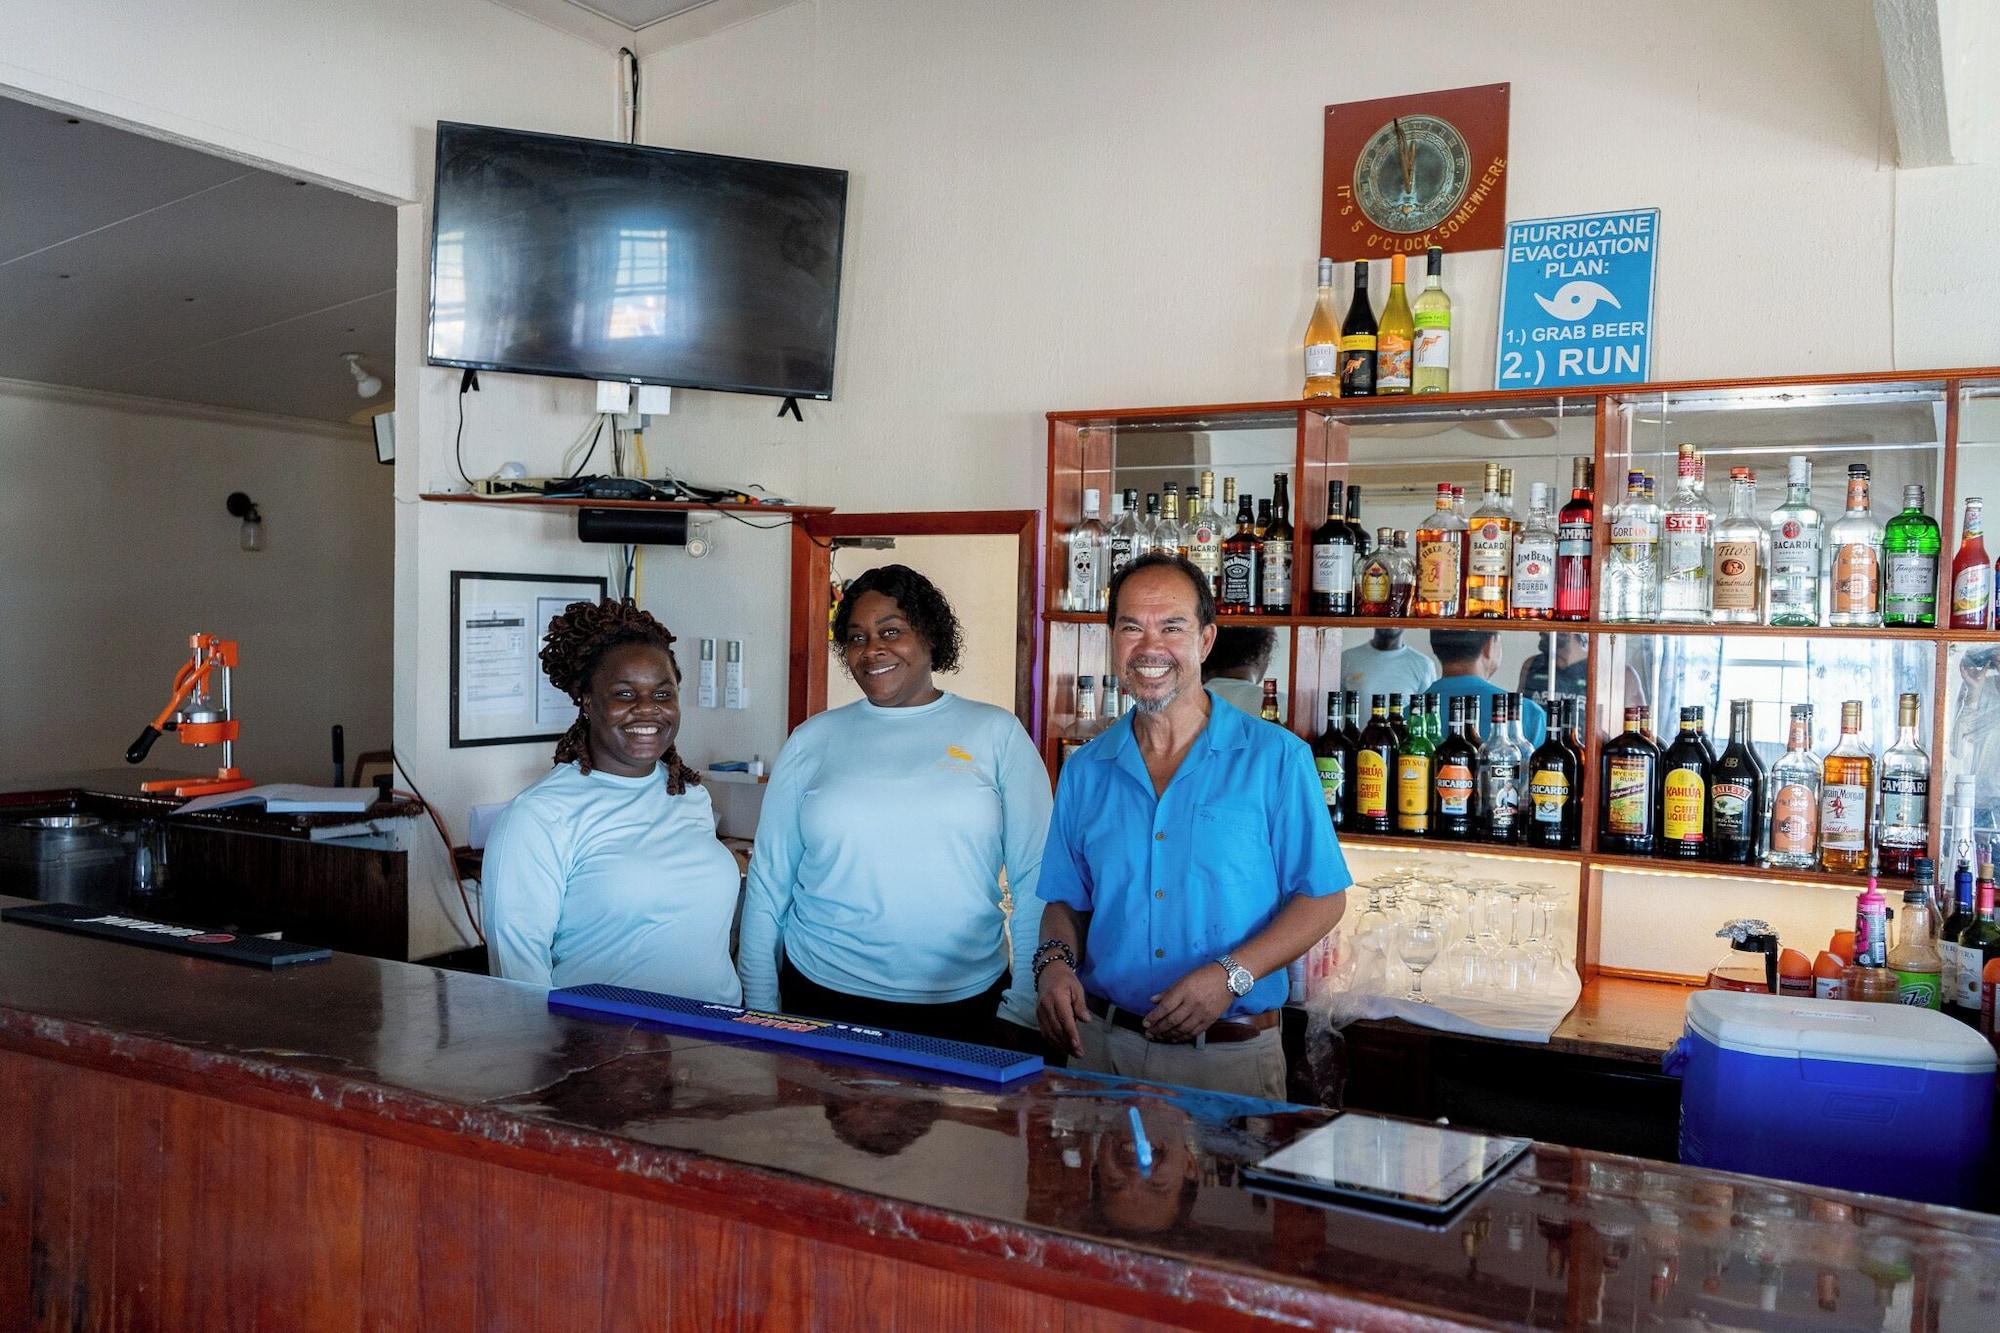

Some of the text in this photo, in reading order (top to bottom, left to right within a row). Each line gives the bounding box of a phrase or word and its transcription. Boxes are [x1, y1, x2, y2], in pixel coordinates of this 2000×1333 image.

[1337, 185, 1353, 216] IT'S
[1351, 219, 1364, 233] 5
[1439, 157, 1507, 239] SOMEWHERE
[1513, 216, 1651, 244] HURRICANE
[1511, 236, 1649, 263] EVACUATION
[1545, 259, 1610, 279] PLAN:
[1506, 321, 1645, 346] 1.) GRAB BEER
[1502, 344, 1641, 385] 2.) RUN
[1669, 516, 1705, 528] STOLI
[1718, 545, 1750, 557] Tito's
[1517, 583, 1548, 591] BOURBON
[1437, 779, 1473, 788] RICARDO
[1531, 785, 1569, 795] RICARDO
[1881, 780, 1927, 793] CAMPARI
